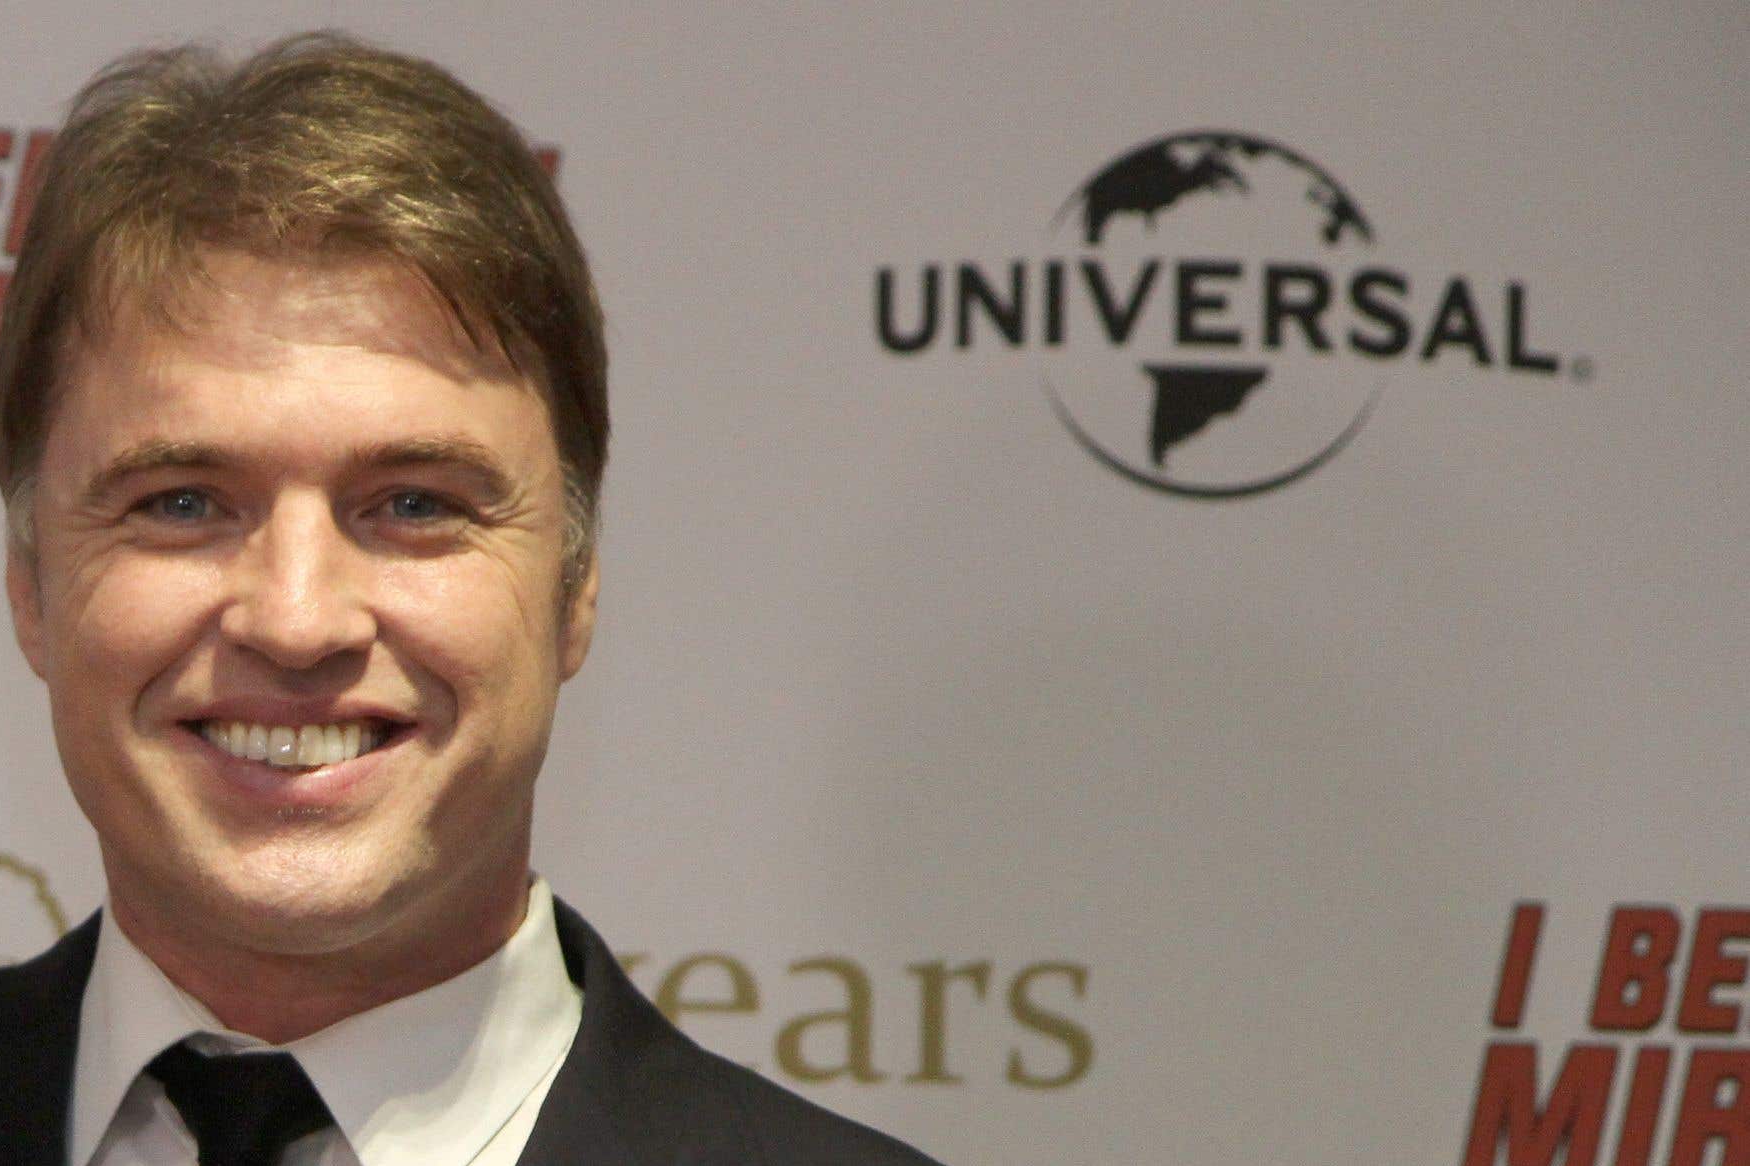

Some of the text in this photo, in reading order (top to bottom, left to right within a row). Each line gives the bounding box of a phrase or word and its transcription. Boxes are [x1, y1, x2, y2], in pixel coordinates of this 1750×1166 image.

[875, 258, 1560, 374] UNIVERSAL
[612, 952, 1095, 1090] ears
[1490, 903, 1545, 1030] I
